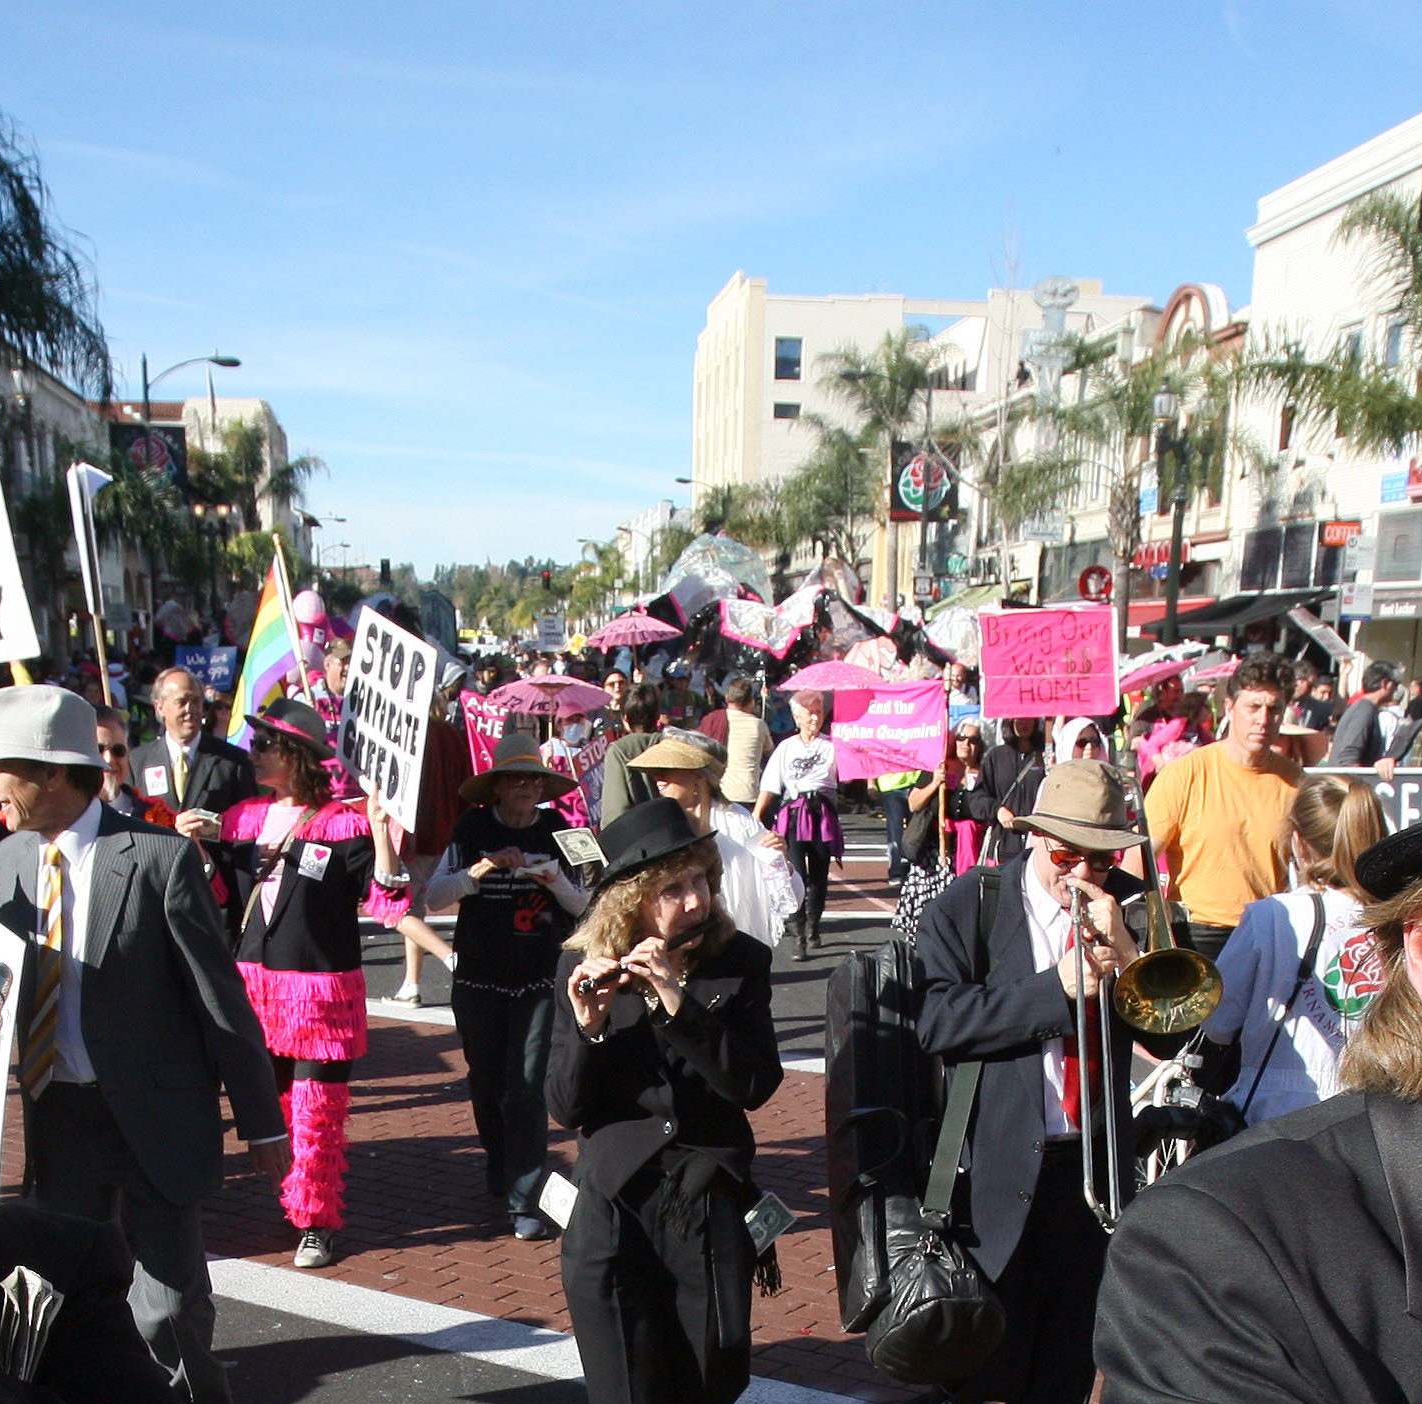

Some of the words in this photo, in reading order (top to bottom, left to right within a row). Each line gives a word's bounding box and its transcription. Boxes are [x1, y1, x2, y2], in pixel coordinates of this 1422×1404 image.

[986, 616, 1053, 655] Bring
[1061, 612, 1107, 641] Our
[186, 653, 207, 665] We
[360, 622, 427, 703] STOP
[1011, 653, 1058, 676] War
[1018, 676, 1090, 704] HOME
[348, 676, 420, 757] CORPORATE
[893, 700, 915, 715] the
[832, 723, 874, 742] Afghan
[876, 720, 942, 744] Quagmire!
[578, 735, 608, 772] STOP
